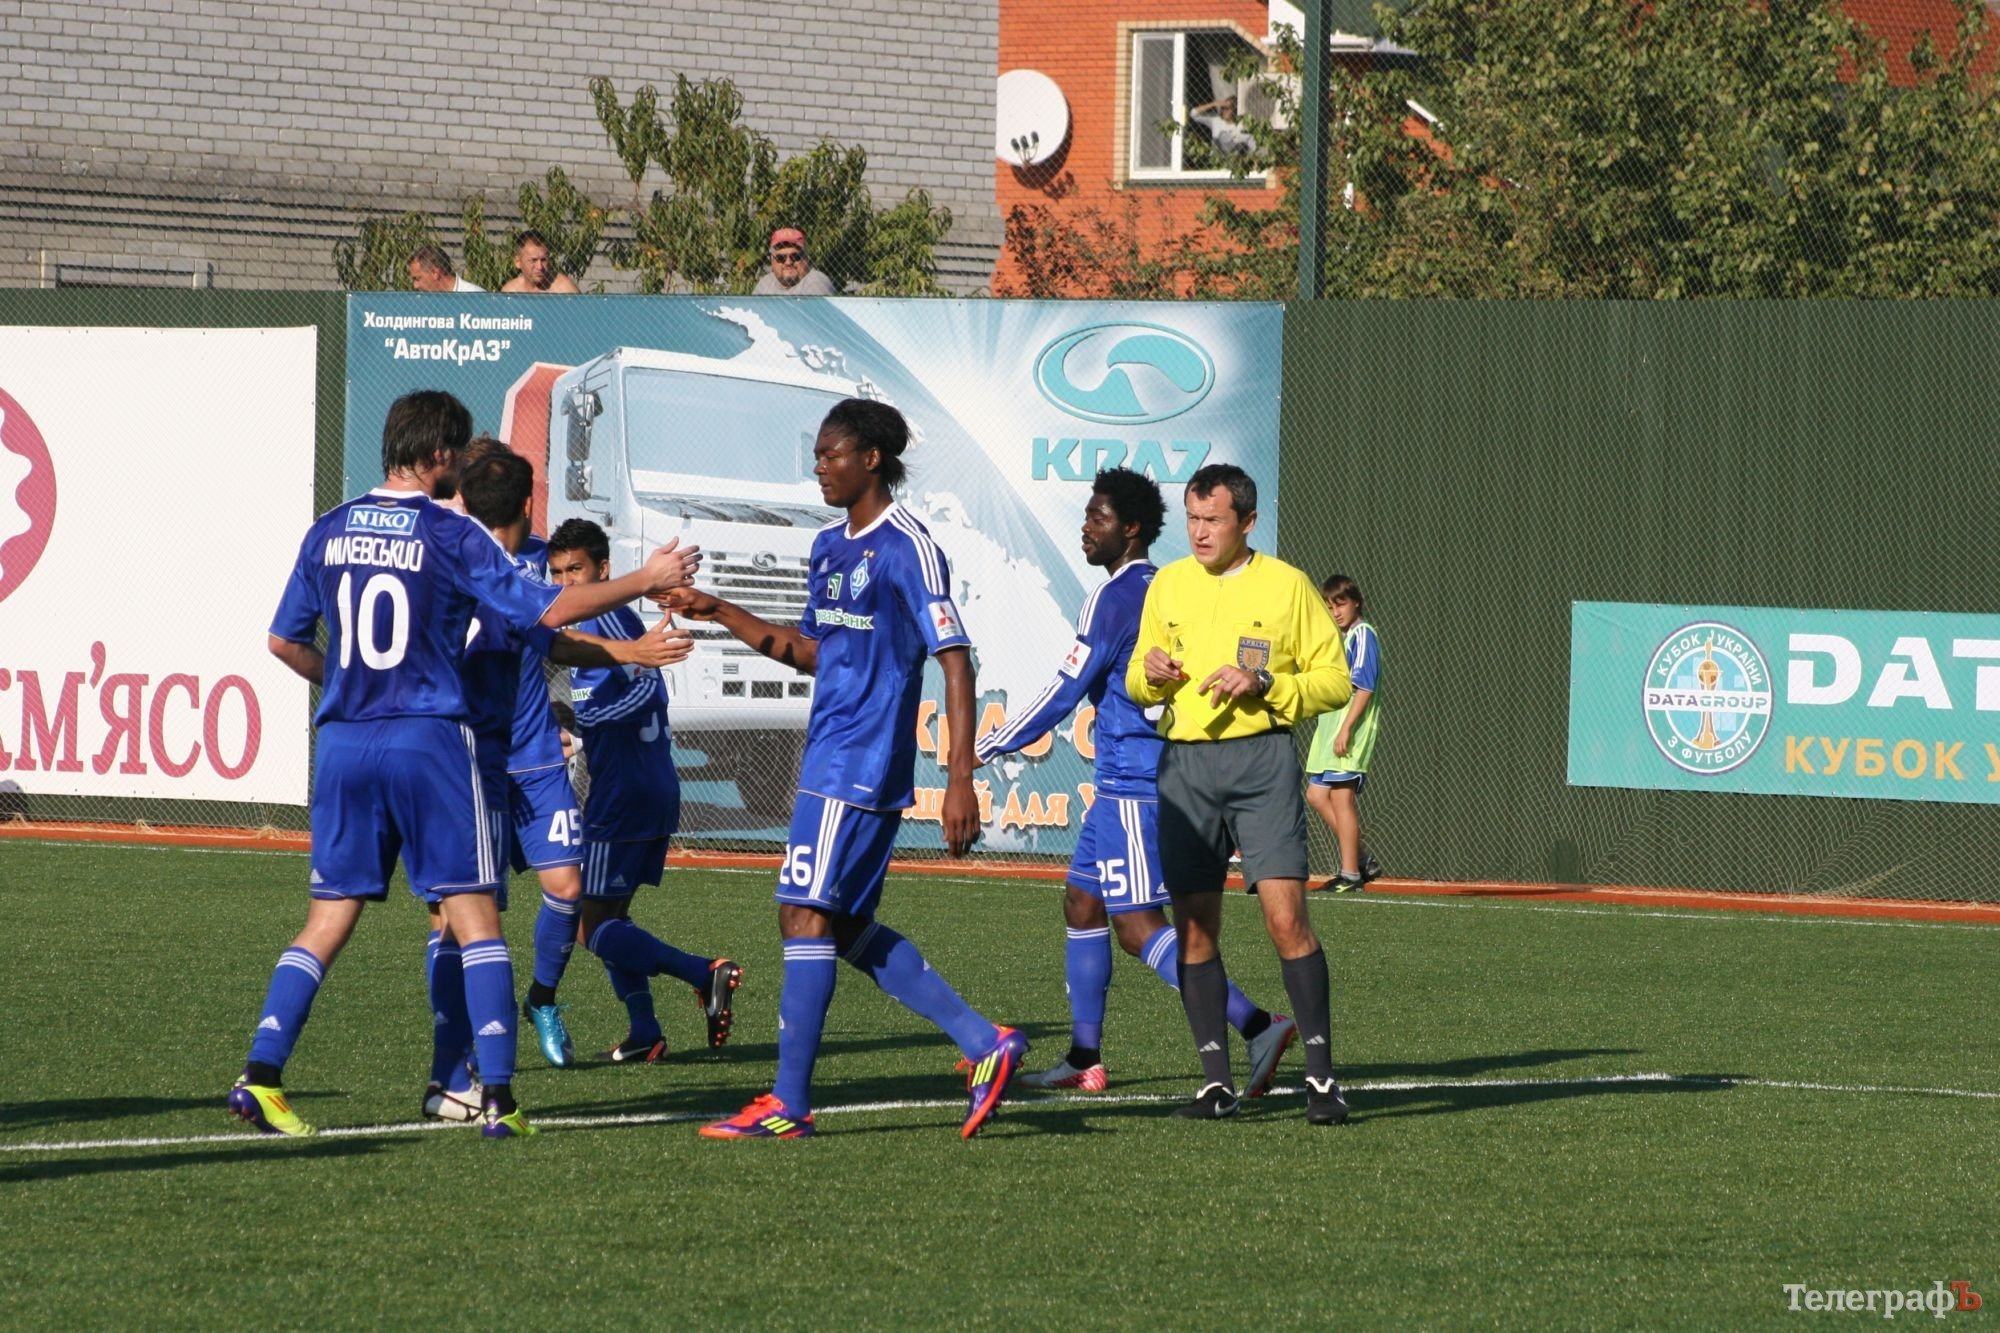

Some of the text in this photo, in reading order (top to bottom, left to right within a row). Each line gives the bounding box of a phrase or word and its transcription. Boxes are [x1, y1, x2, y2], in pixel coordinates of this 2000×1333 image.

[363, 311, 532, 331] Холдингова Компанія
[350, 510, 410, 529] NIKO
[337, 571, 410, 670] 10
[1656, 633, 1762, 685] КУБОК УКРАЇНИ
[1649, 693, 1767, 709] DATAGROUP
[1682, 730, 1752, 764] ФУТБОЛУ
[1785, 736, 1966, 781] КУБОК
